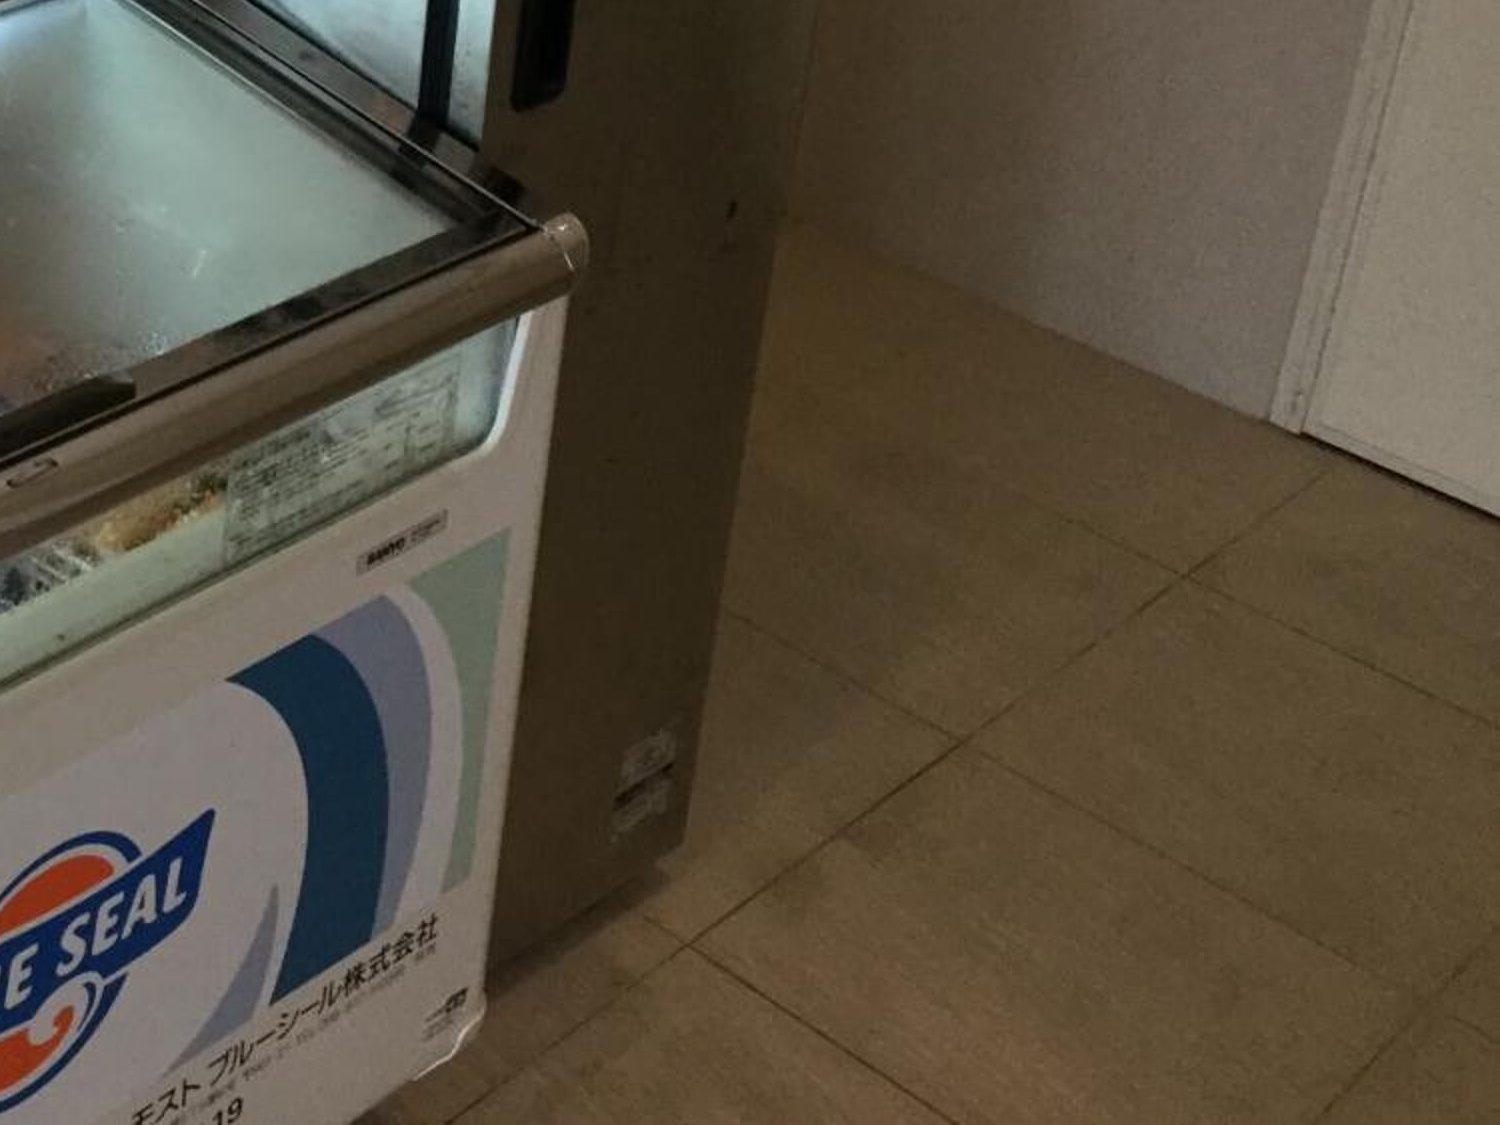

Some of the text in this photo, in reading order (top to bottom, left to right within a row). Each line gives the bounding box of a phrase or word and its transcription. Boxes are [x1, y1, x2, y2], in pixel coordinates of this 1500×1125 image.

[56, 857, 188, 977] SEAL
[208, 911, 439, 1086] ブルーシール株式会社
